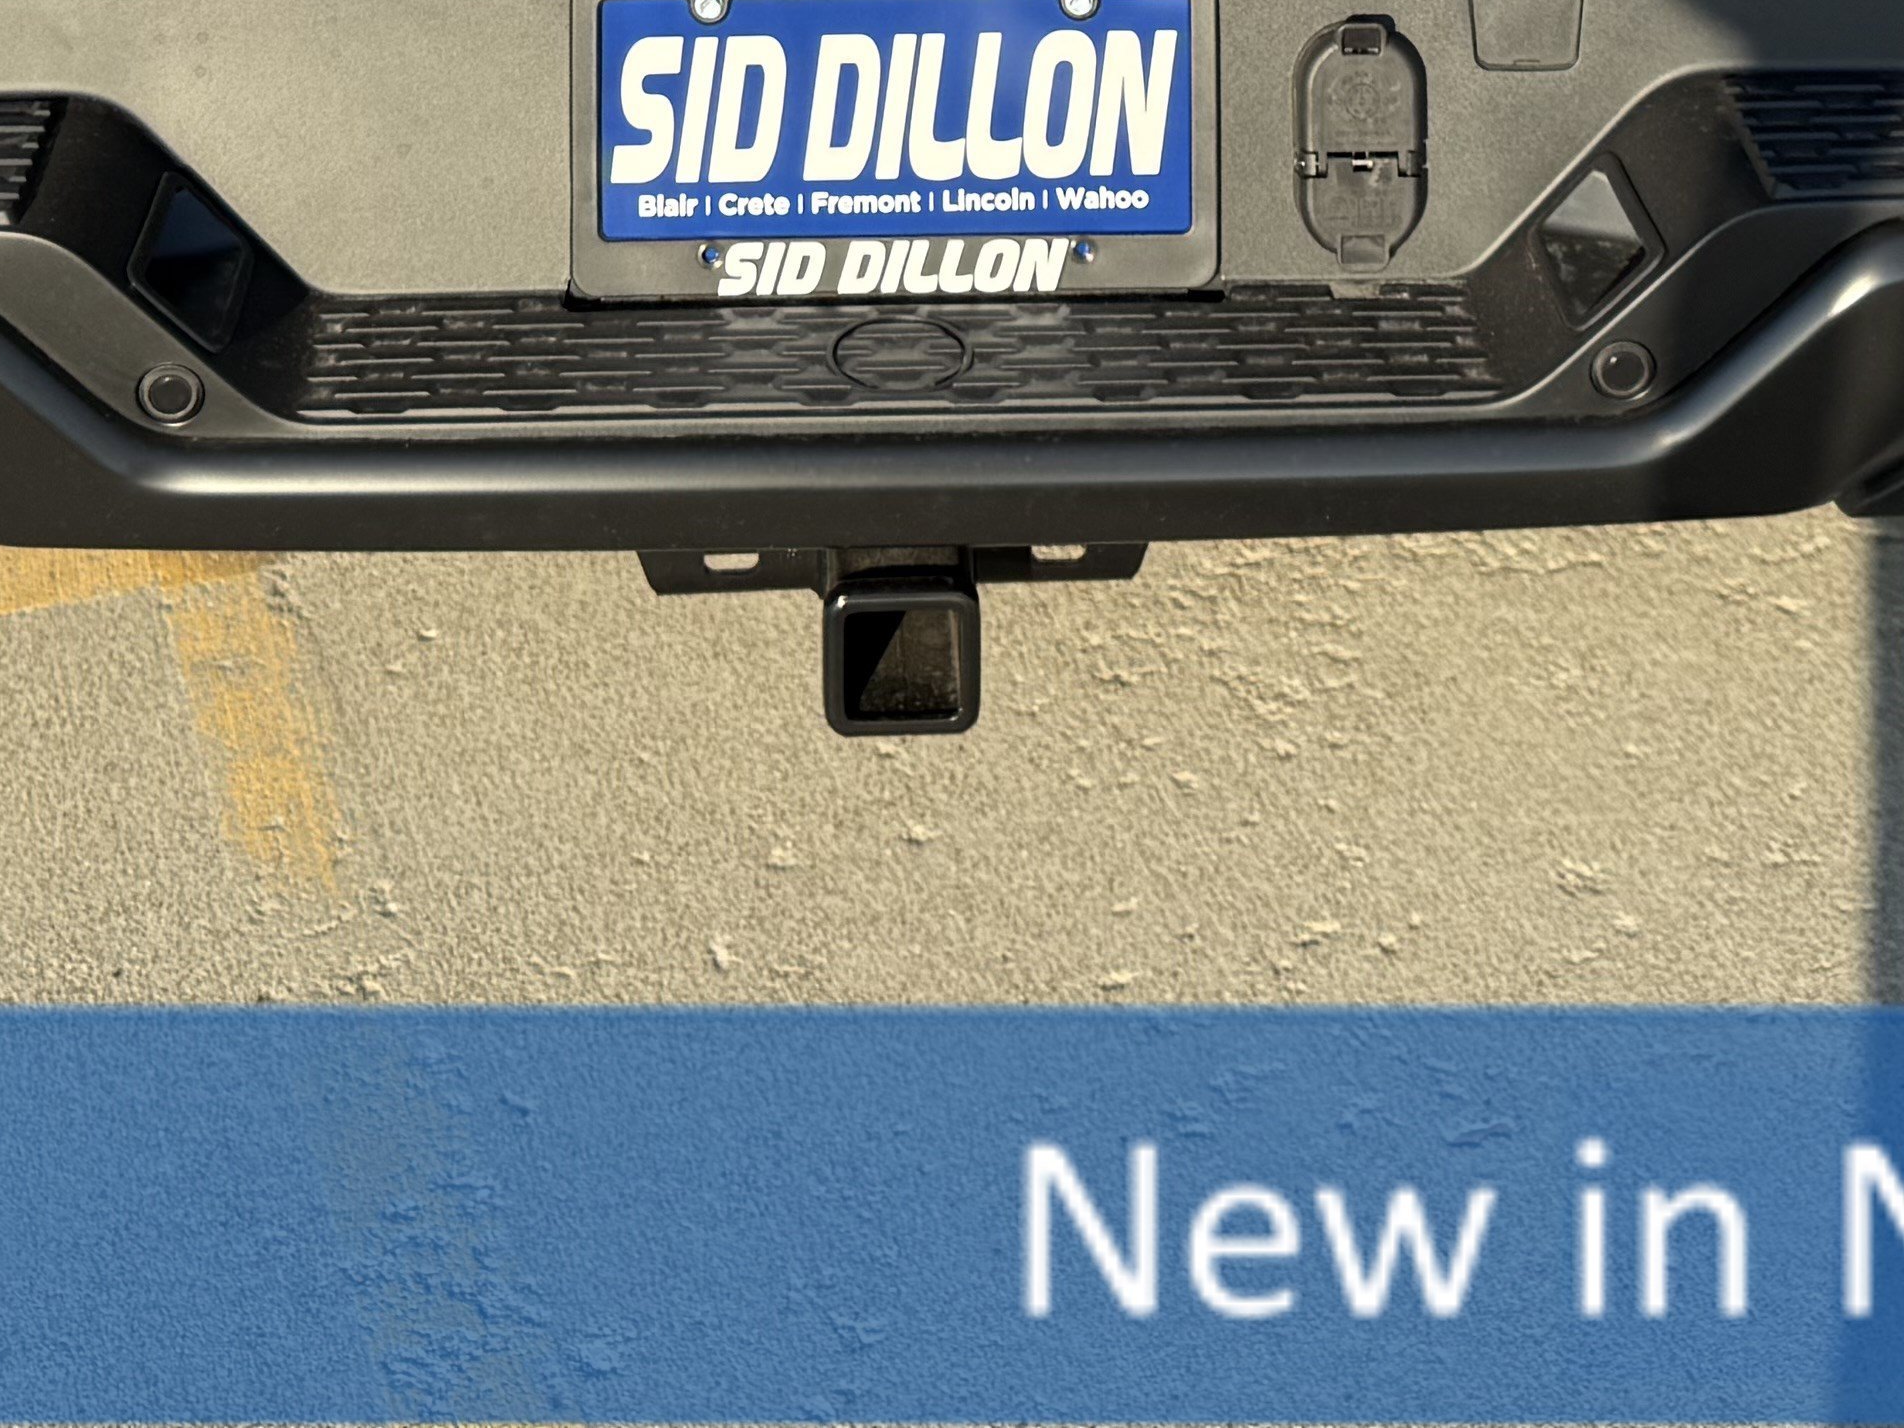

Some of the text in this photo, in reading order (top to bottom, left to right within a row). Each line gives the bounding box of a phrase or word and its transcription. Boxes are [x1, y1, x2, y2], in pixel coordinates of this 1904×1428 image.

[610, 35, 788, 184] SID
[802, 29, 1178, 182] DILLON
[638, 194, 699, 218] Blair
[719, 193, 790, 217] Crete
[811, 190, 922, 215] Fremont
[942, 188, 1036, 213] Lincoln
[1056, 187, 1149, 211] Wahoo
[717, 237, 1069, 297] SID DILLON
